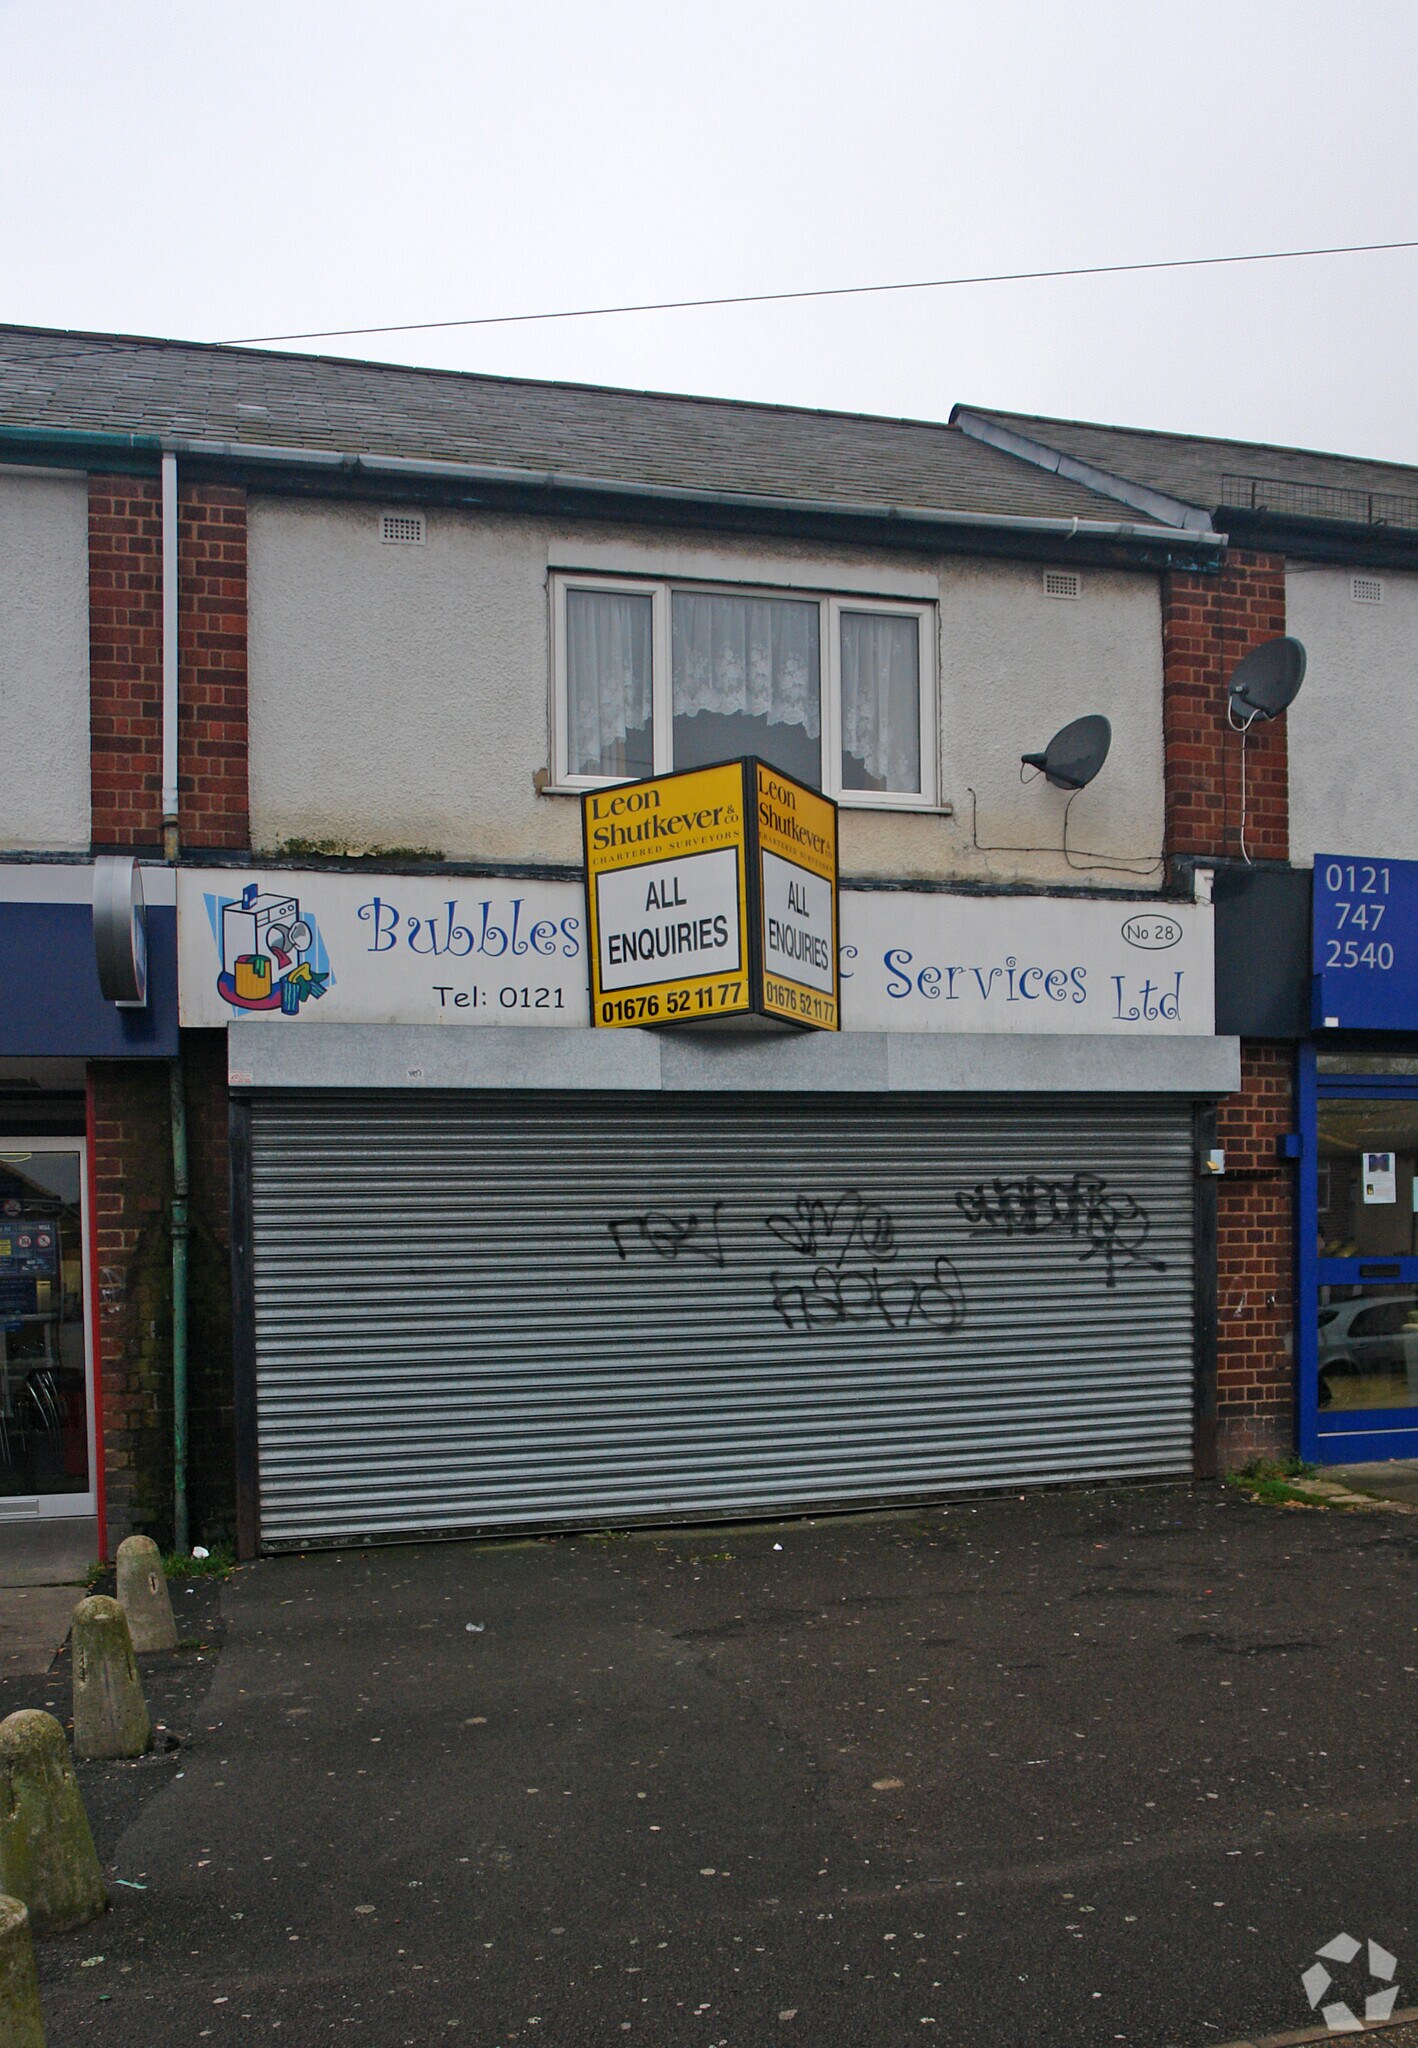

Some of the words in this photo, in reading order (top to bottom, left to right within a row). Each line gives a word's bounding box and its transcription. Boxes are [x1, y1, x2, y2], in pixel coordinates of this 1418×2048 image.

[592, 789, 661, 820] Leon
[759, 771, 796, 810] Leon
[593, 806, 723, 850] Shutkever
[726, 804, 735, 814] &
[724, 814, 739, 825] CO
[759, 802, 825, 854] Shutkever
[593, 845, 663, 865] CHARTERED
[669, 831, 740, 850] SURVEYORS
[645, 877, 687, 911] ALL
[1326, 864, 1390, 895] 0121
[788, 881, 810, 918] ALL
[357, 897, 580, 958] Bubbles
[1127, 924, 1149, 940] No
[1155, 925, 1174, 940] 28
[1335, 903, 1386, 932] 747
[608, 915, 729, 965] ENQUIRIES
[768, 918, 829, 971] ENQUIRIES
[1326, 940, 1394, 970] 2540
[433, 985, 487, 1008] Tel:
[499, 986, 565, 1009] 0121
[767, 981, 797, 1011] 01676
[884, 949, 1087, 1003] Services
[1110, 971, 1185, 1021] Ltd
[602, 994, 659, 1023] 01676
